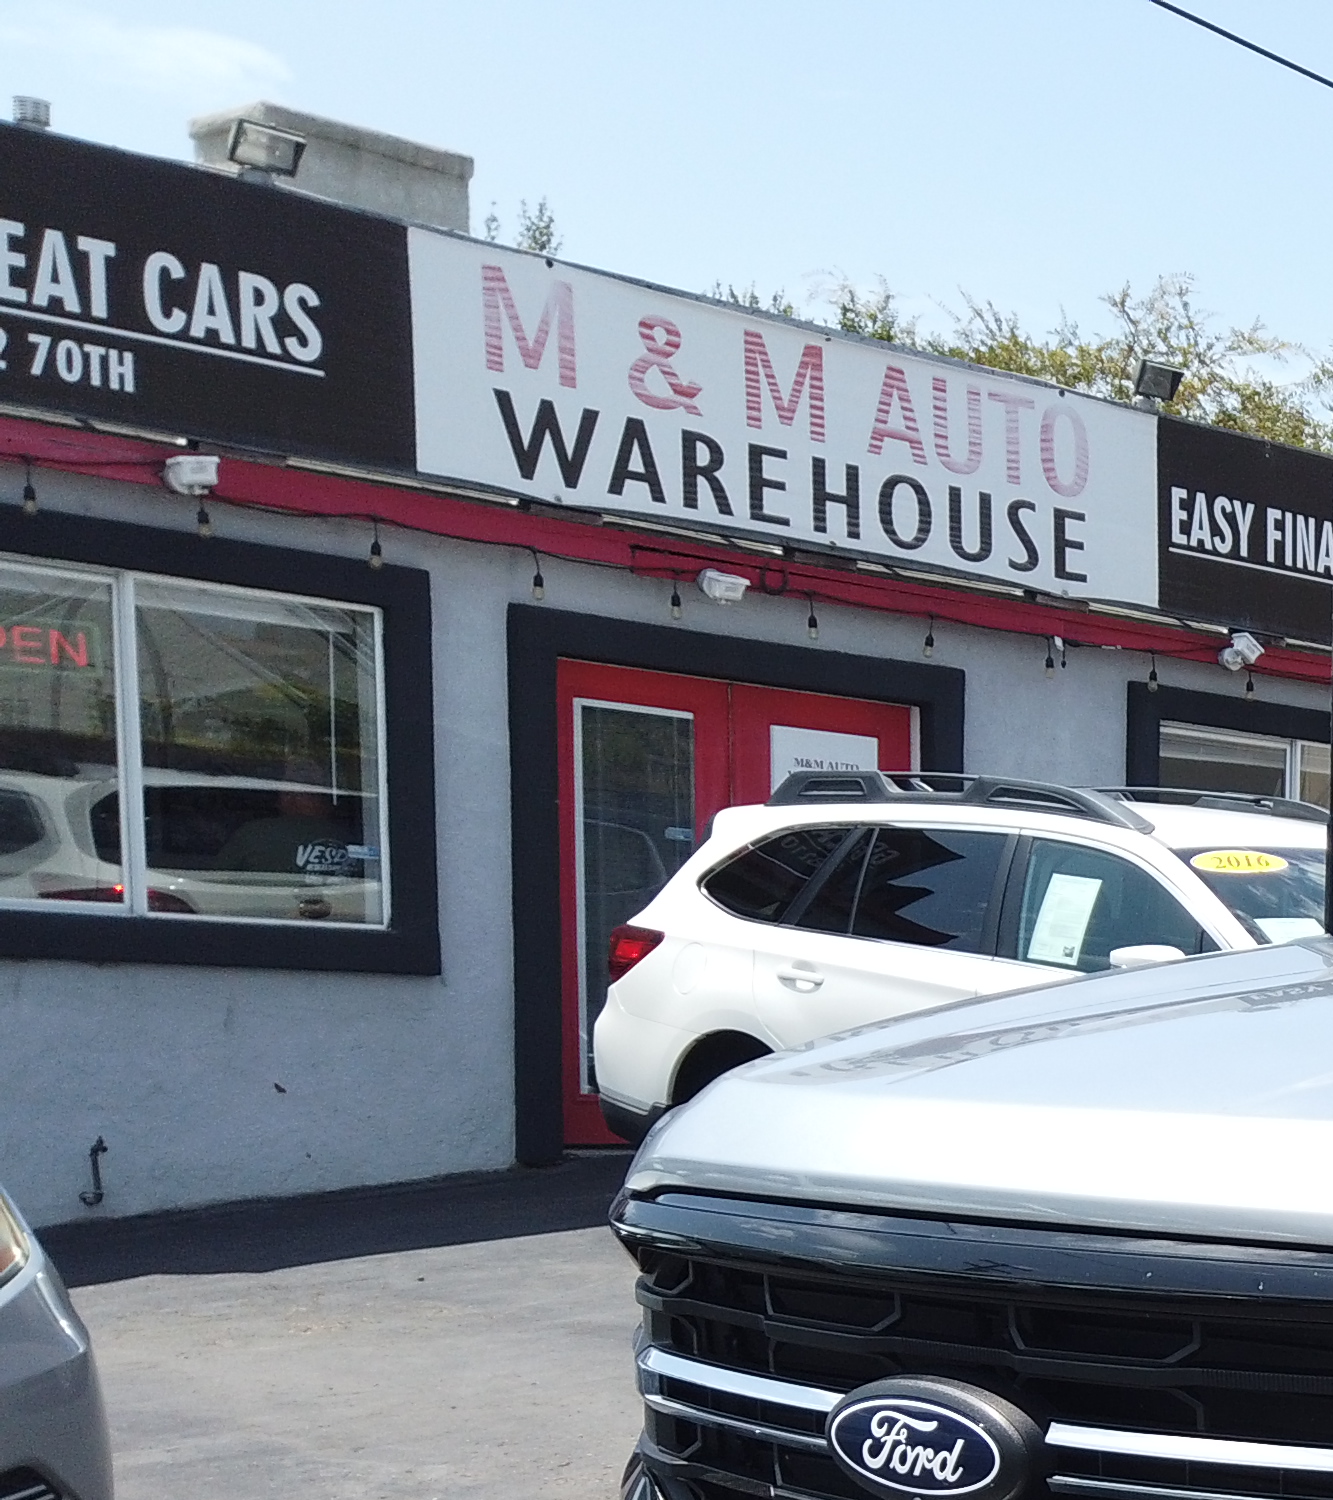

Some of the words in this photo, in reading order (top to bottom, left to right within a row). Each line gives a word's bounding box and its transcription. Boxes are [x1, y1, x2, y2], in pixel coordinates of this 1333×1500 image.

[0, 218, 116, 320] EAT
[143, 250, 323, 363] CARS
[27, 332, 137, 393] 70TH
[481, 264, 577, 389] M
[628, 314, 704, 417] &
[743, 329, 826, 443] M
[866, 364, 1090, 498] AUTO
[492, 387, 1089, 584] WAREHOUSE
[1171, 486, 1256, 557] EASY
[0, 625, 88, 667] EN
[793, 757, 824, 770] M&M
[1210, 855, 1270, 869] 2016
[861, 1409, 964, 1482] Ford
